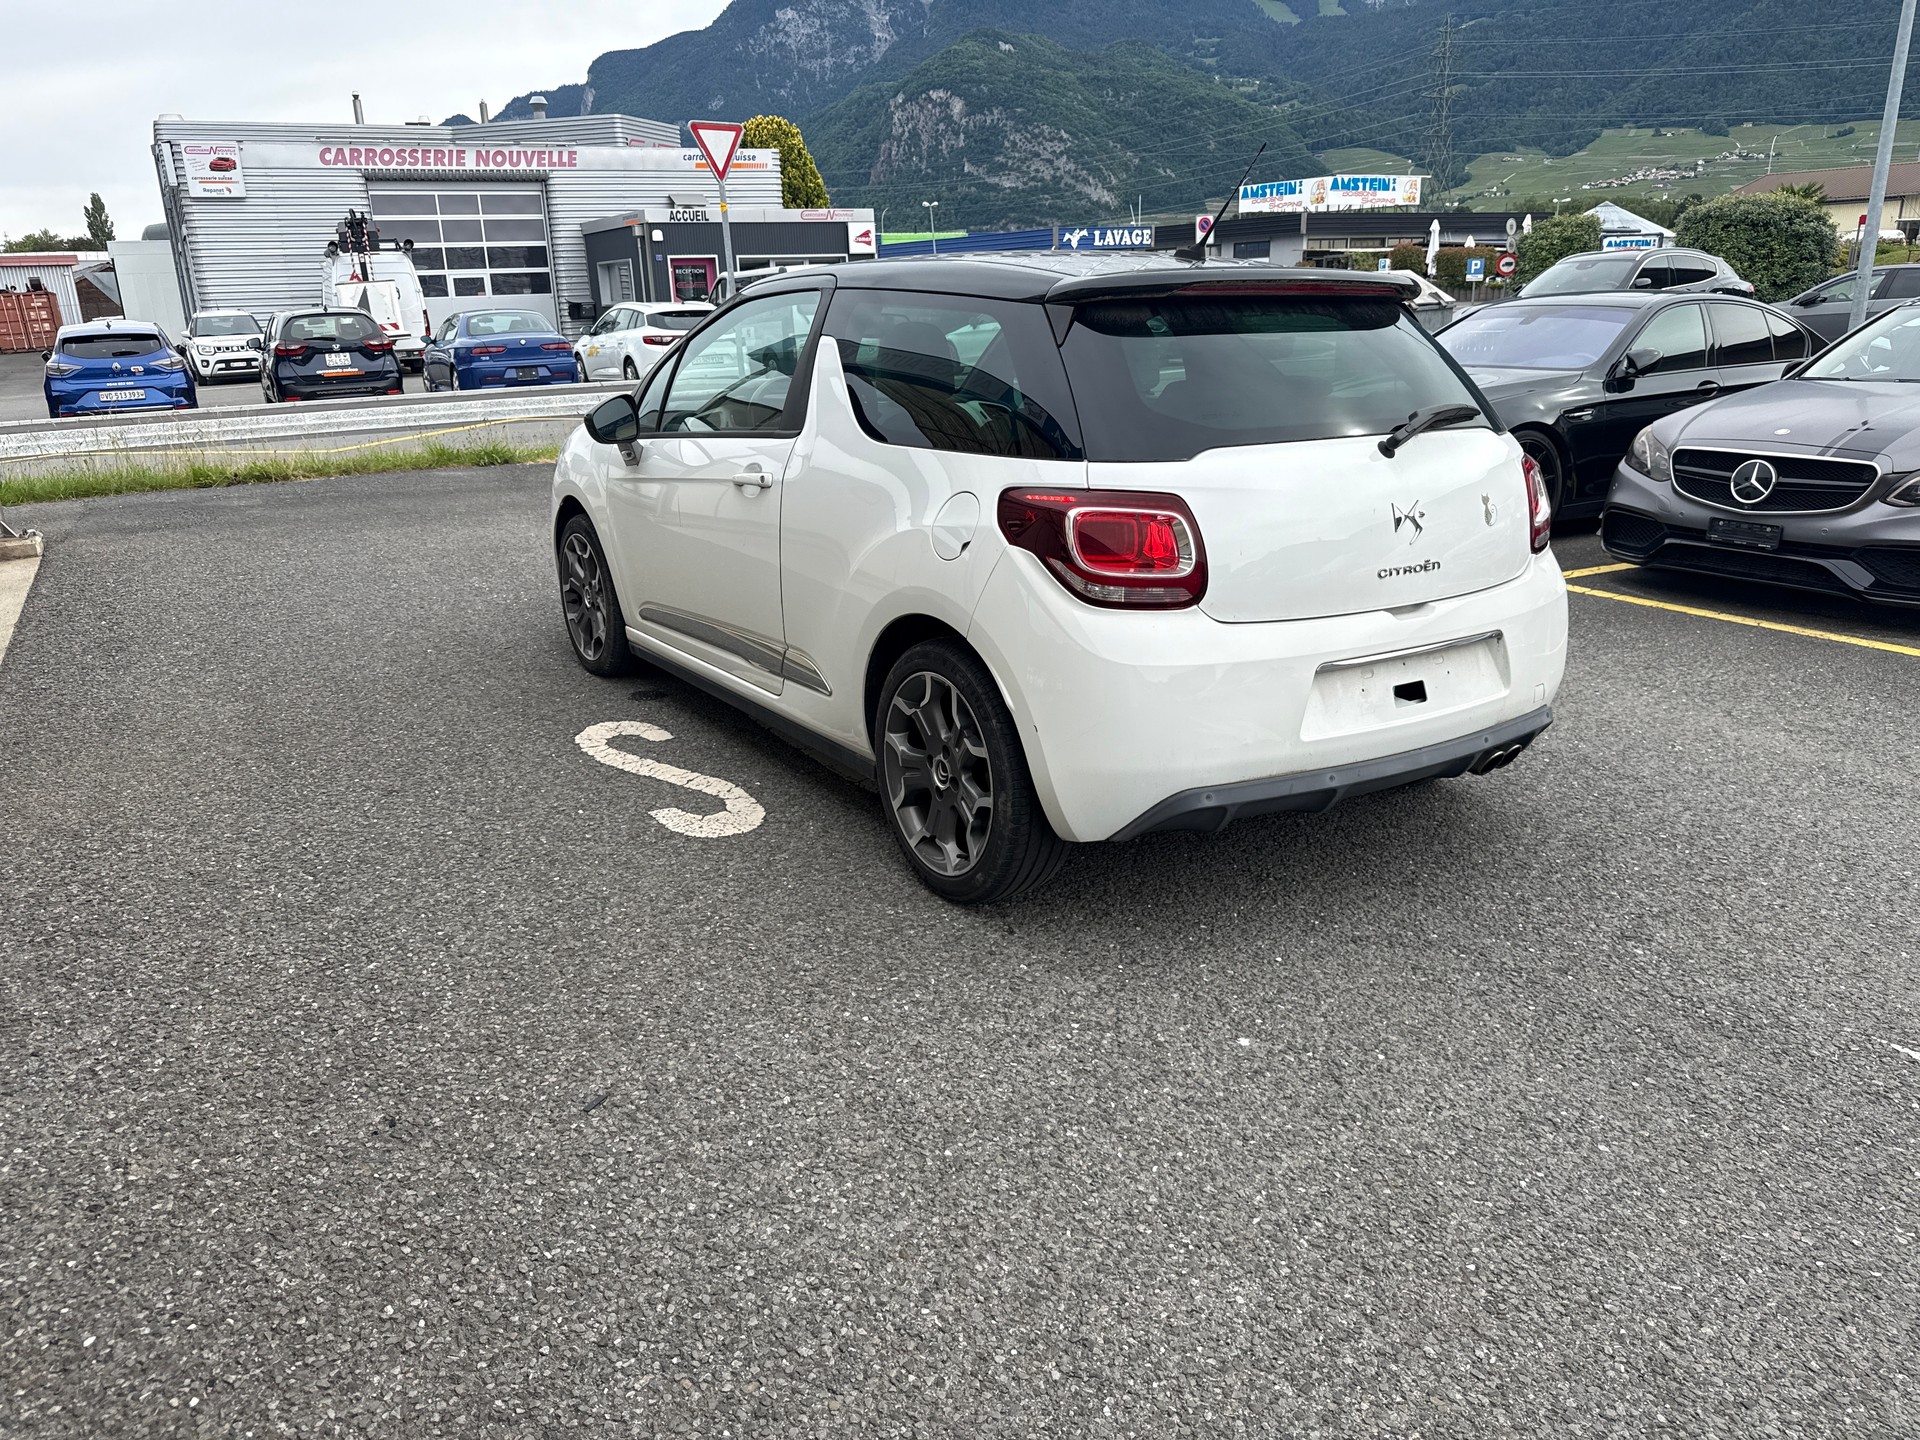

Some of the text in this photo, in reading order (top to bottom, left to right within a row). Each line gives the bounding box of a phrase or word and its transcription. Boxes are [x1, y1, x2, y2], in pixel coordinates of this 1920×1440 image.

[318, 146, 578, 168] CARROSSERIE NOUVELLE
[734, 151, 757, 161] uisse
[1241, 181, 1297, 200] AMSTEIN
[1330, 177, 1391, 192] AMSTEIN
[669, 210, 710, 222] ACCUEIL
[1093, 229, 1152, 247] LAVAGE
[1606, 239, 1652, 248] AMSTEIN
[1470, 260, 1481, 274] P
[574, 720, 766, 839] S
